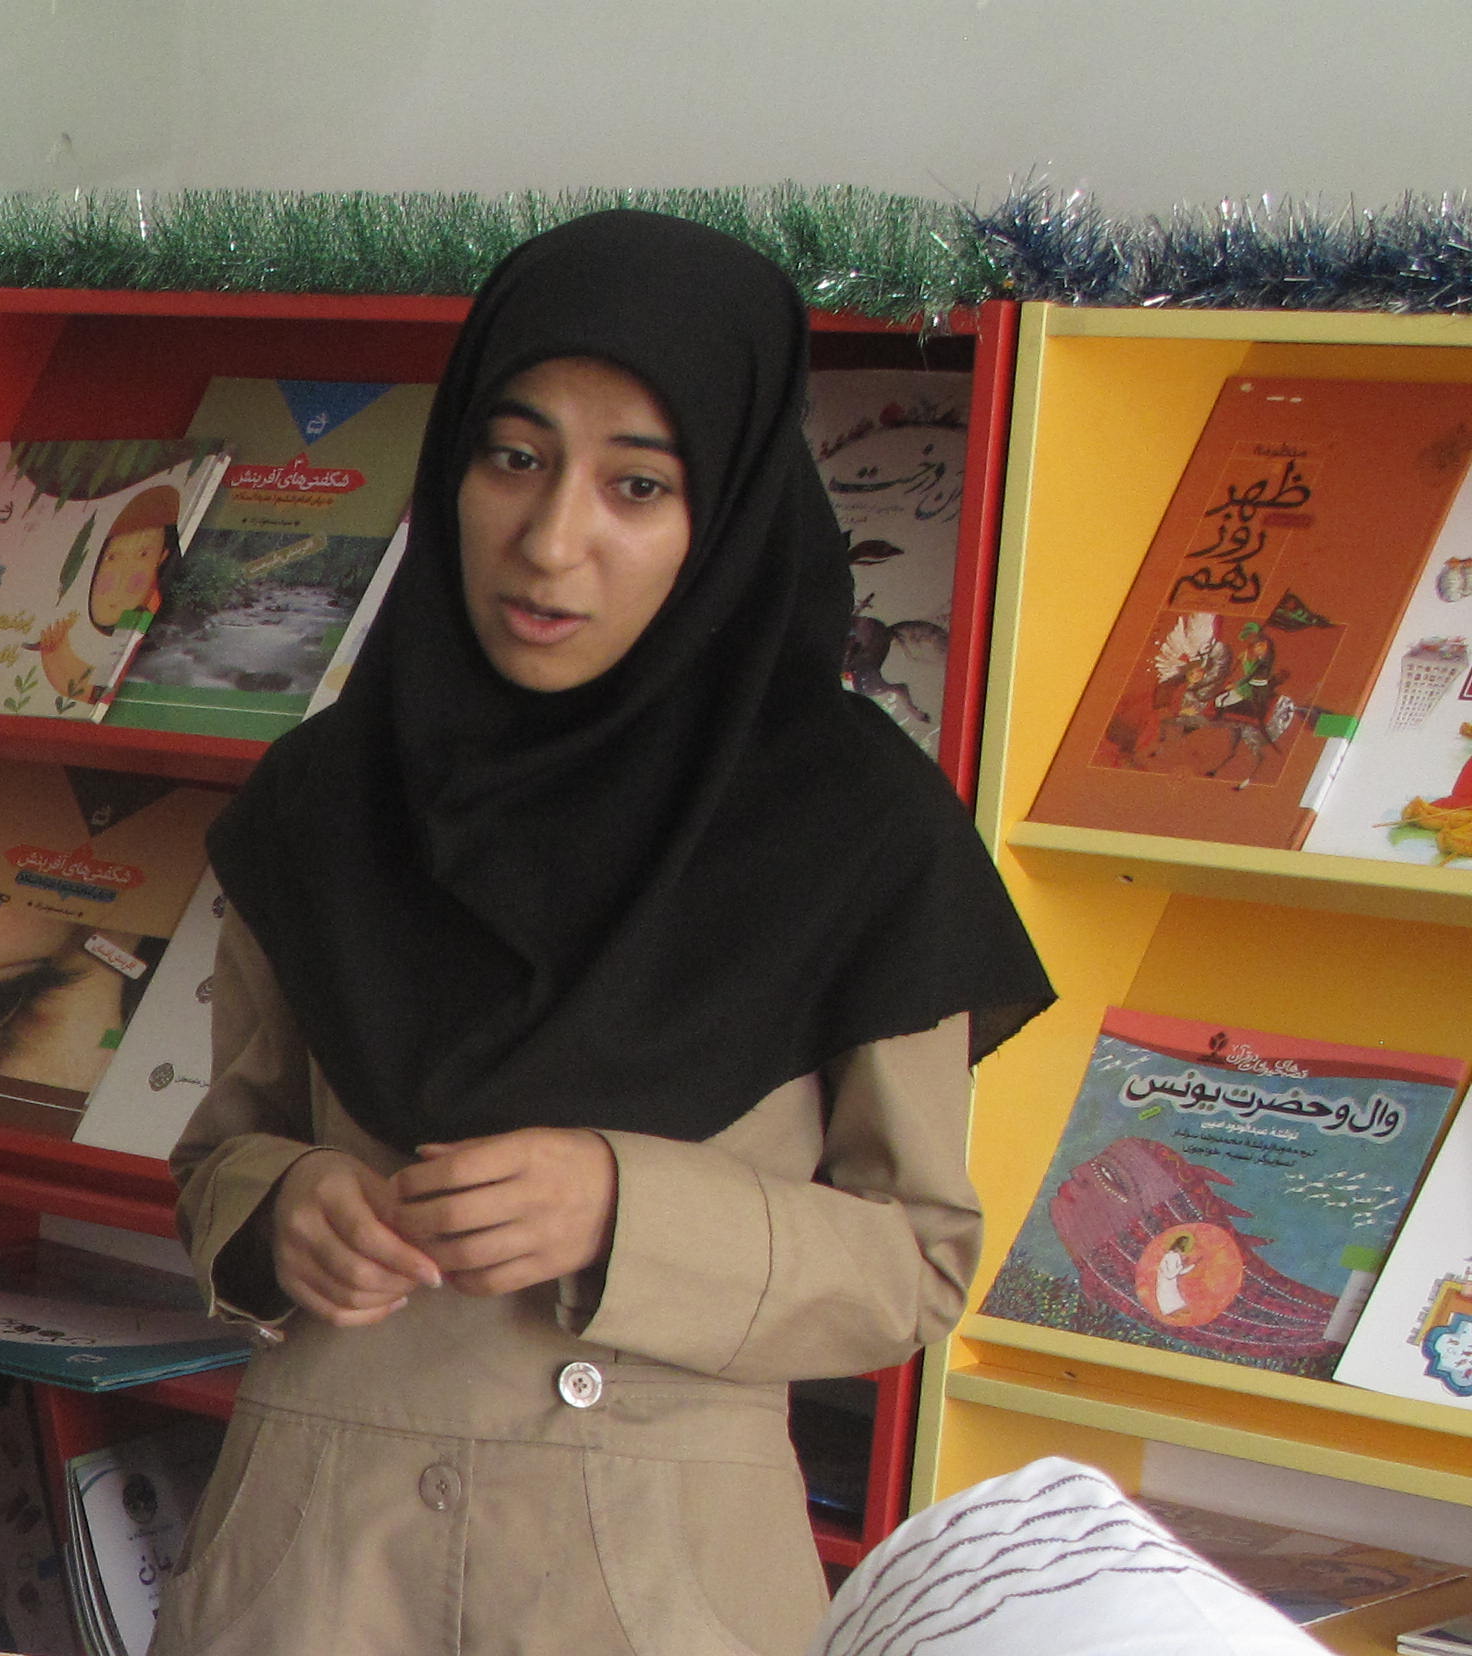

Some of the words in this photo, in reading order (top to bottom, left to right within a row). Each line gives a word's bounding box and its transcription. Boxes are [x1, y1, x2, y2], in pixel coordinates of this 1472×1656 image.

[1205, 459, 1311, 522] ظهر
[1184, 513, 1267, 564] روز
[1168, 563, 1260, 608] دهم
[1125, 1070, 1222, 1110] یونس
[1222, 1087, 1334, 1119] حضرت
[1323, 1103, 1350, 1130] و
[1348, 1098, 1400, 1138] وال
